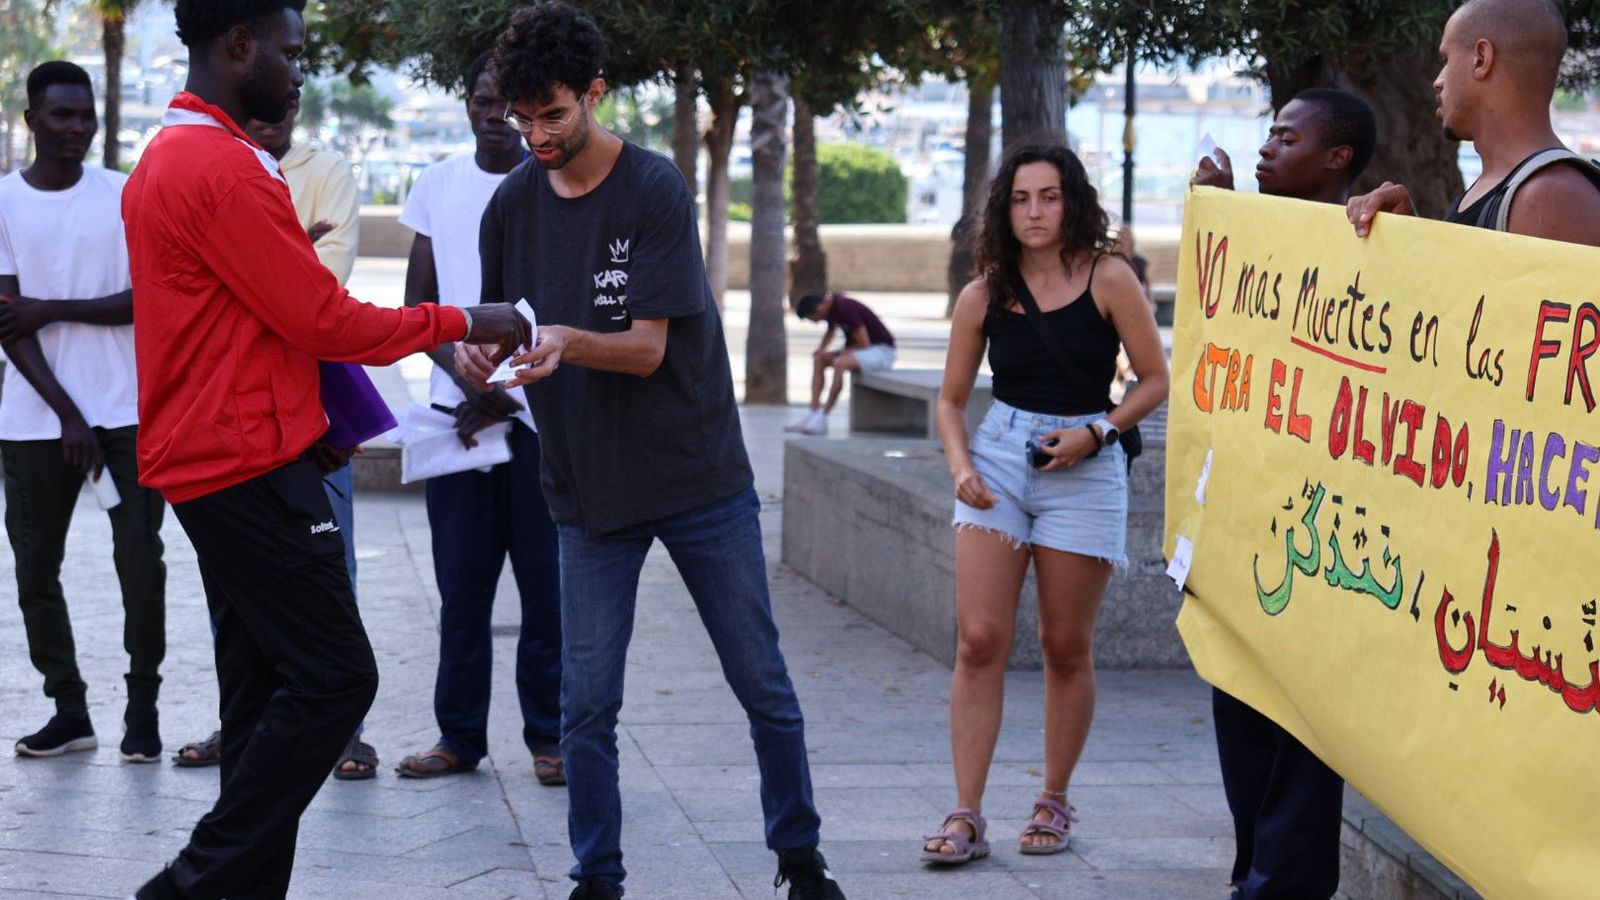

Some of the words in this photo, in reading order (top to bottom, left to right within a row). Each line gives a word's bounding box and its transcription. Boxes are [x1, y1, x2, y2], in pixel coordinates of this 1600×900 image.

[1232, 253, 1282, 320] más
[1291, 266, 1392, 354] Muertes
[1409, 310, 1439, 369] en
[1465, 294, 1504, 387] las
[1264, 358, 1312, 443] EL
[1328, 375, 1473, 502] OLVIDO,
[1484, 419, 1600, 530] HACE
